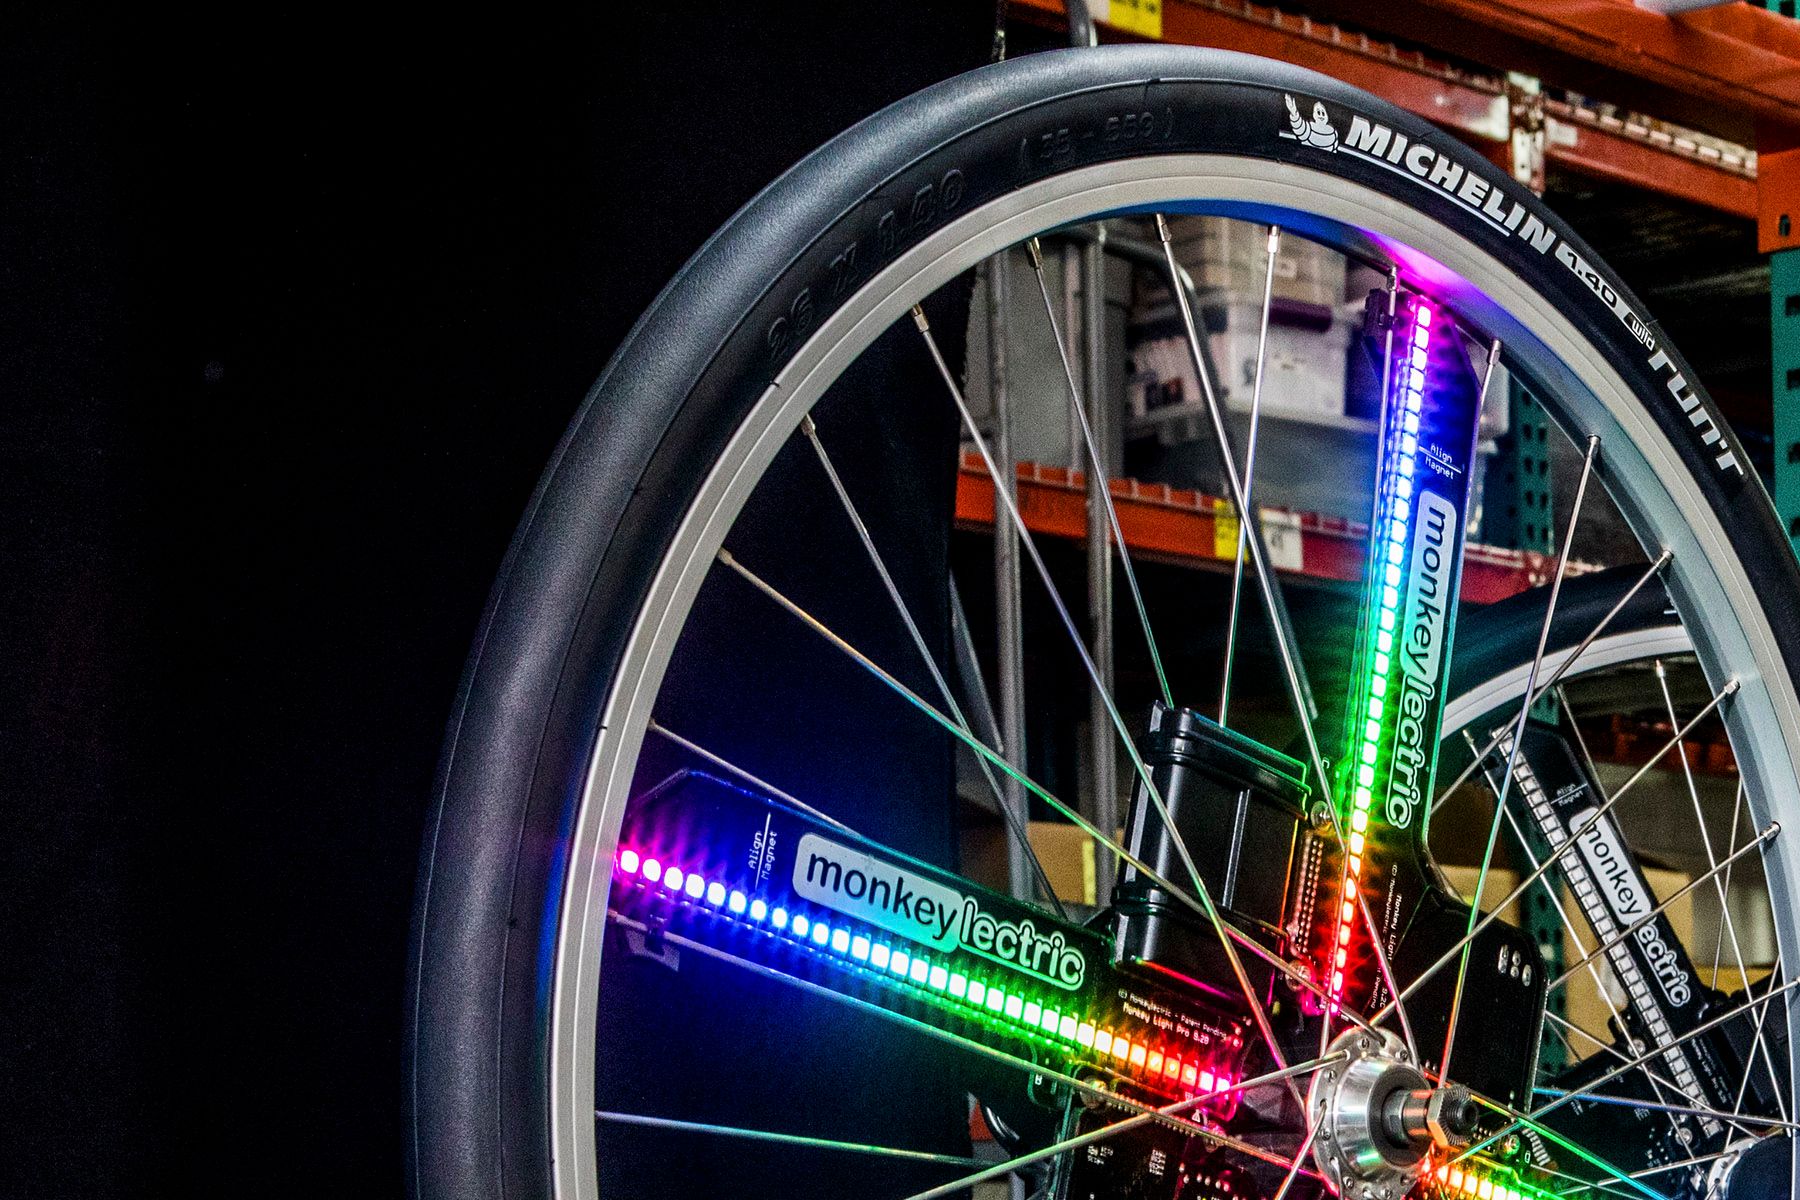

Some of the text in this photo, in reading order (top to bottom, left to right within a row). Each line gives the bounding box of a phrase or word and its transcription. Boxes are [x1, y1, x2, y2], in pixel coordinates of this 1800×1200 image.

[1345, 116, 1556, 255] MICHELIN
[1565, 250, 1619, 309] 1.40
[1631, 319, 1656, 351] wild
[1425, 455, 1455, 481] Magnet
[1430, 442, 1453, 464] Align
[1386, 505, 1447, 829] monkeylectric
[1555, 782, 1577, 798] Align
[747, 830, 763, 870] Align
[760, 830, 778, 881] Magnet
[806, 852, 1086, 991] monkeylectric
[1387, 893, 1402, 960] Monkey Light
[1579, 817, 1692, 1007] monkeyectric
[1122, 1001, 1150, 1025] Monkey
[1152, 1014, 1173, 1032] Light
[1176, 1022, 1190, 1039] Pro
